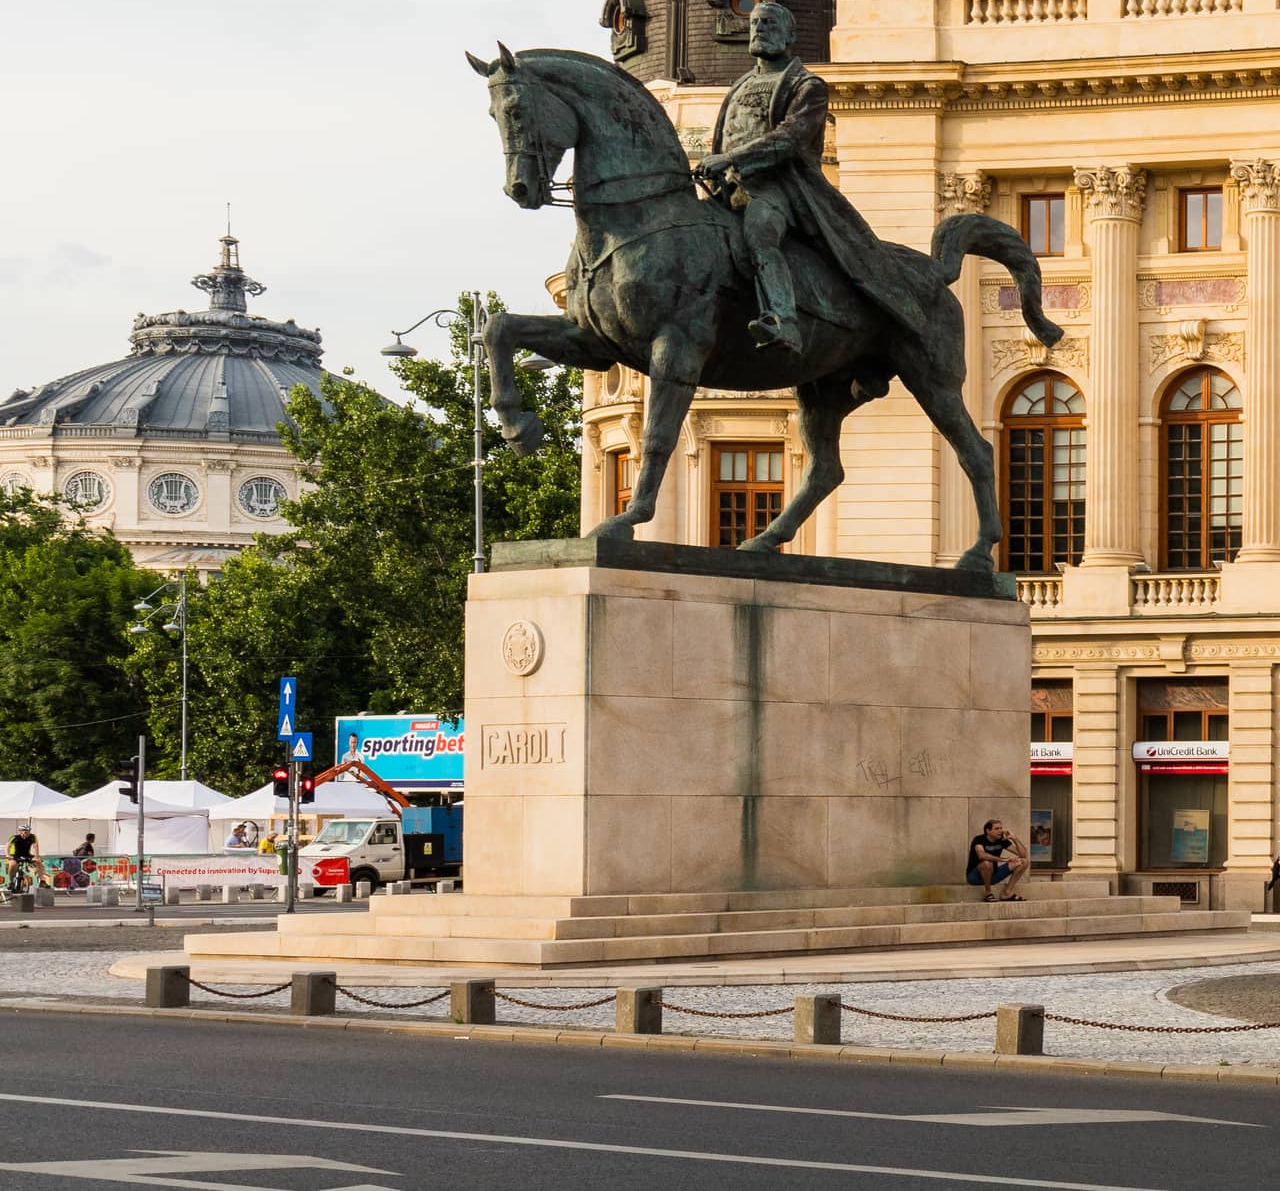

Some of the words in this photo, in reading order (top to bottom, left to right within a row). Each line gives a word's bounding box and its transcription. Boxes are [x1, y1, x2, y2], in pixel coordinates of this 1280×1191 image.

[363, 733, 464, 758] sportingbet
[488, 730, 553, 764] CAROL
[1041, 747, 1062, 757] Bank
[1157, 746, 1195, 756] UniCredit
[1196, 746, 1218, 756] Bank
